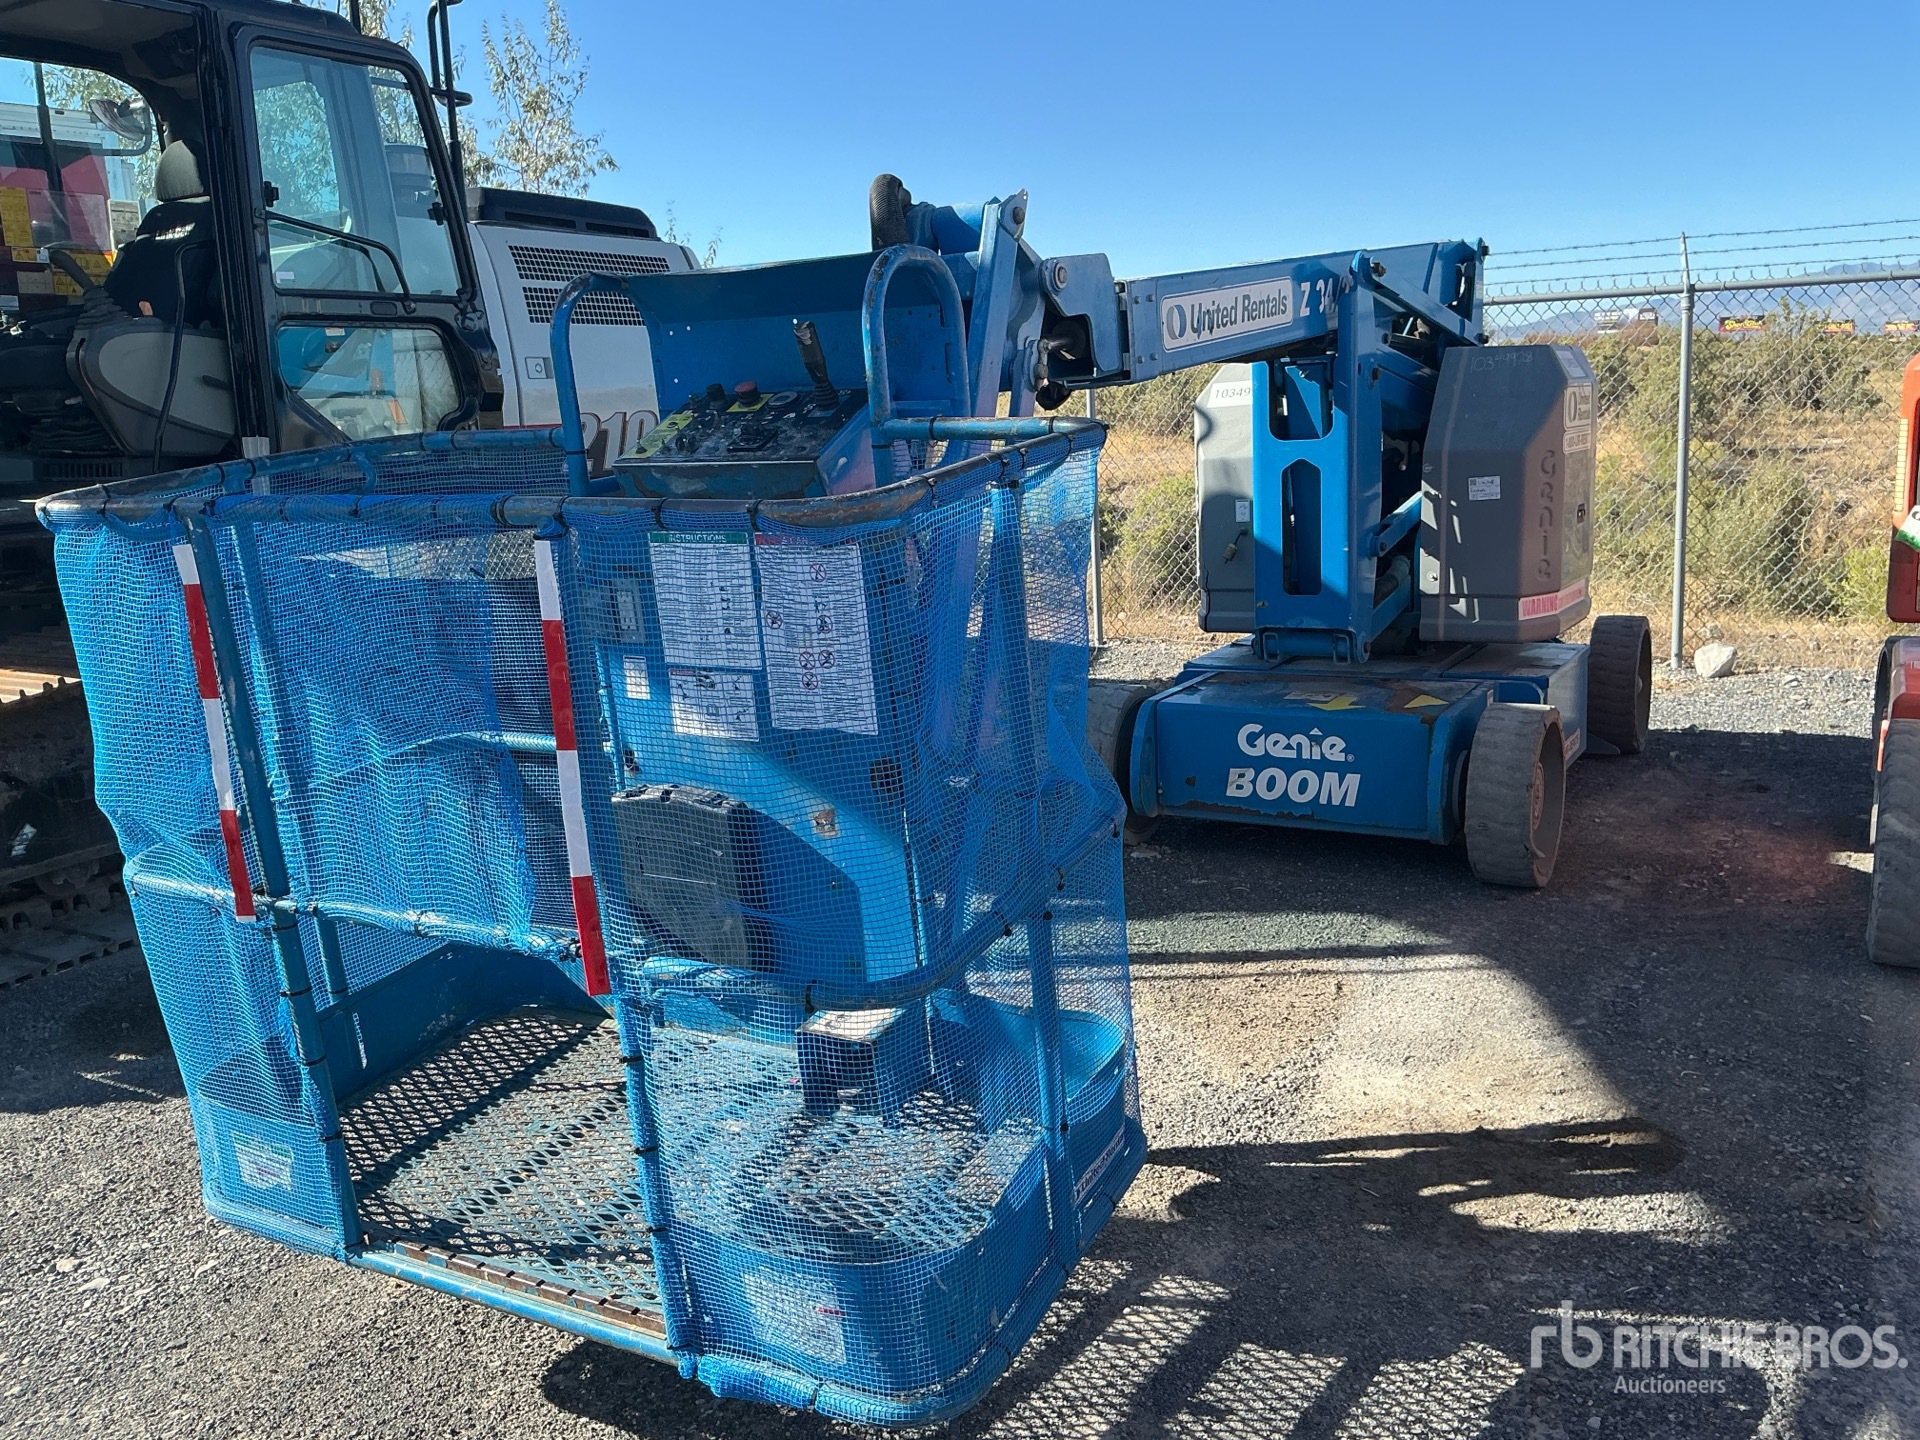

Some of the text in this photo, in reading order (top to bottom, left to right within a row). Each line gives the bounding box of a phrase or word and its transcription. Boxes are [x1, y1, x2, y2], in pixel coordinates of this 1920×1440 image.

[1190, 288, 1288, 335] United Rentals
[1300, 281, 1311, 317] Z
[669, 533, 727, 543] INSTRUCTIONS
[1237, 723, 1347, 762] Genie
[1226, 767, 1361, 807] BOOM
